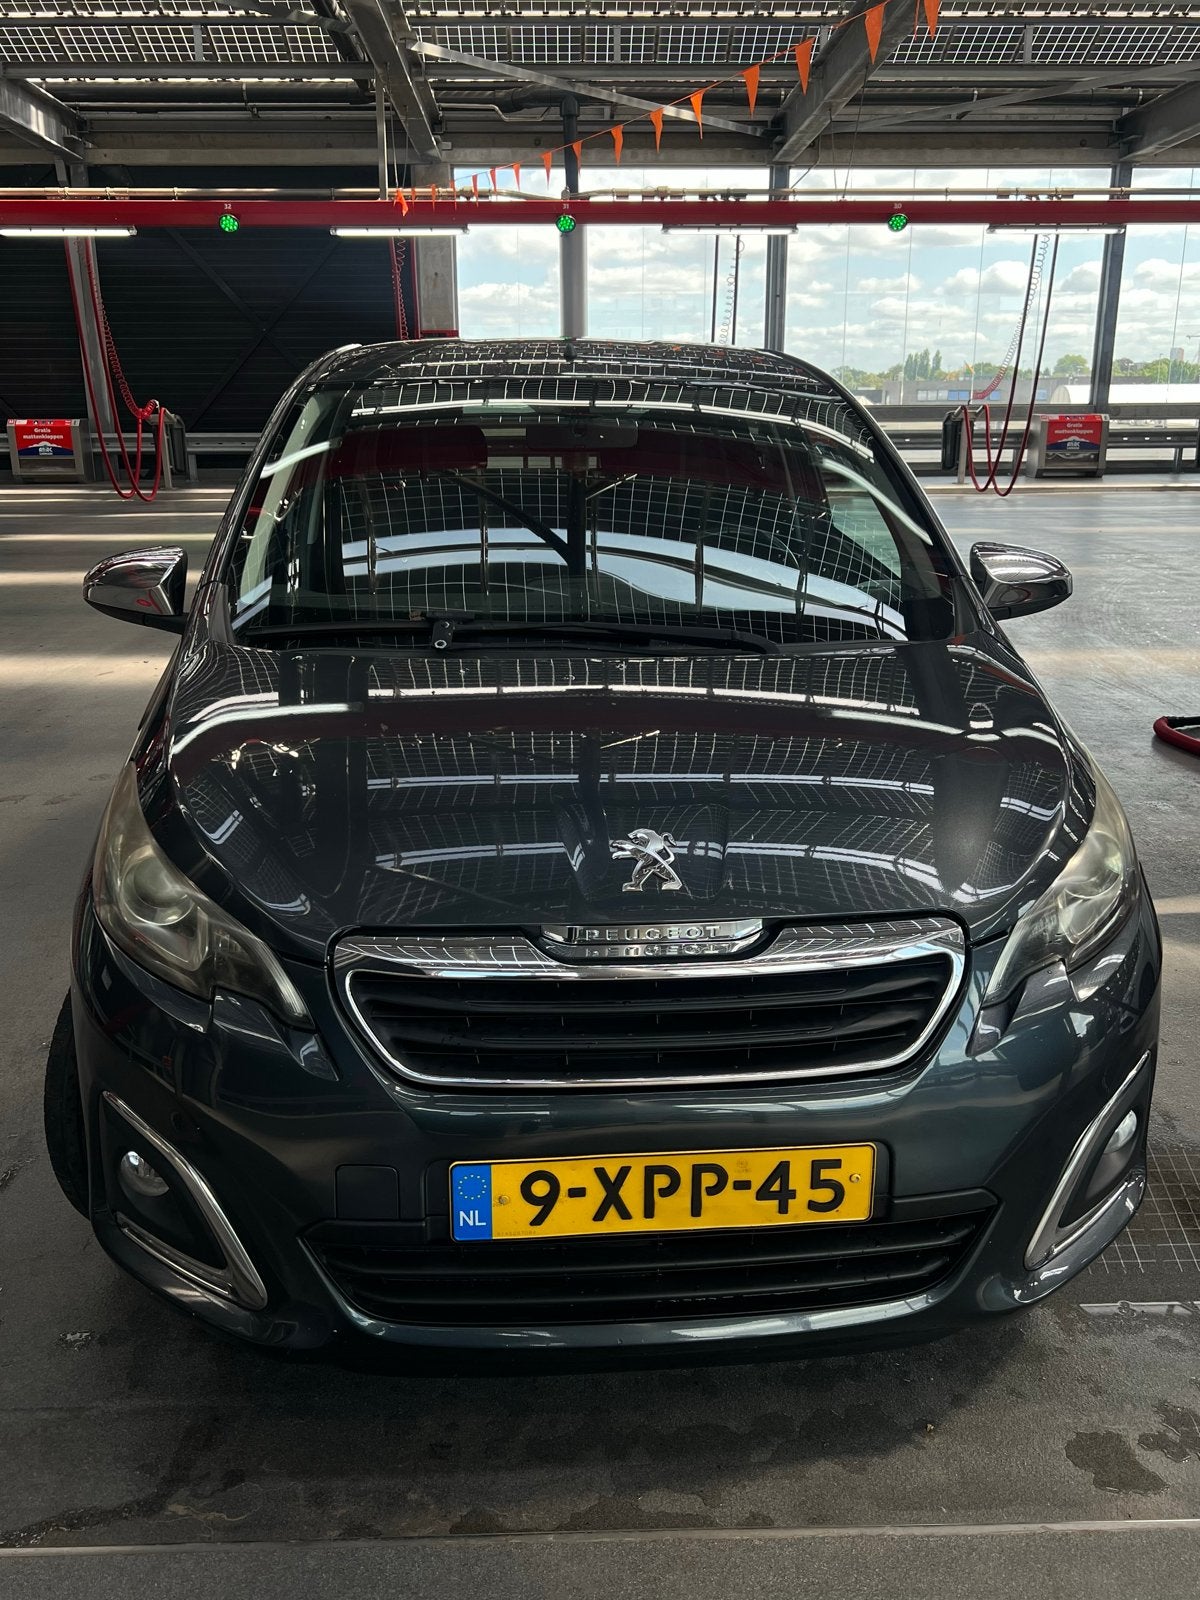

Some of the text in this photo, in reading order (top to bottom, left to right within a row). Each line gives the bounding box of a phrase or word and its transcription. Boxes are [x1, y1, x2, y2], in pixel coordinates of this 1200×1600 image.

[585, 925, 721, 941] PEUGEOT
[520, 1158, 846, 1226] 9-XPP-45
[459, 1210, 487, 1227] NL
